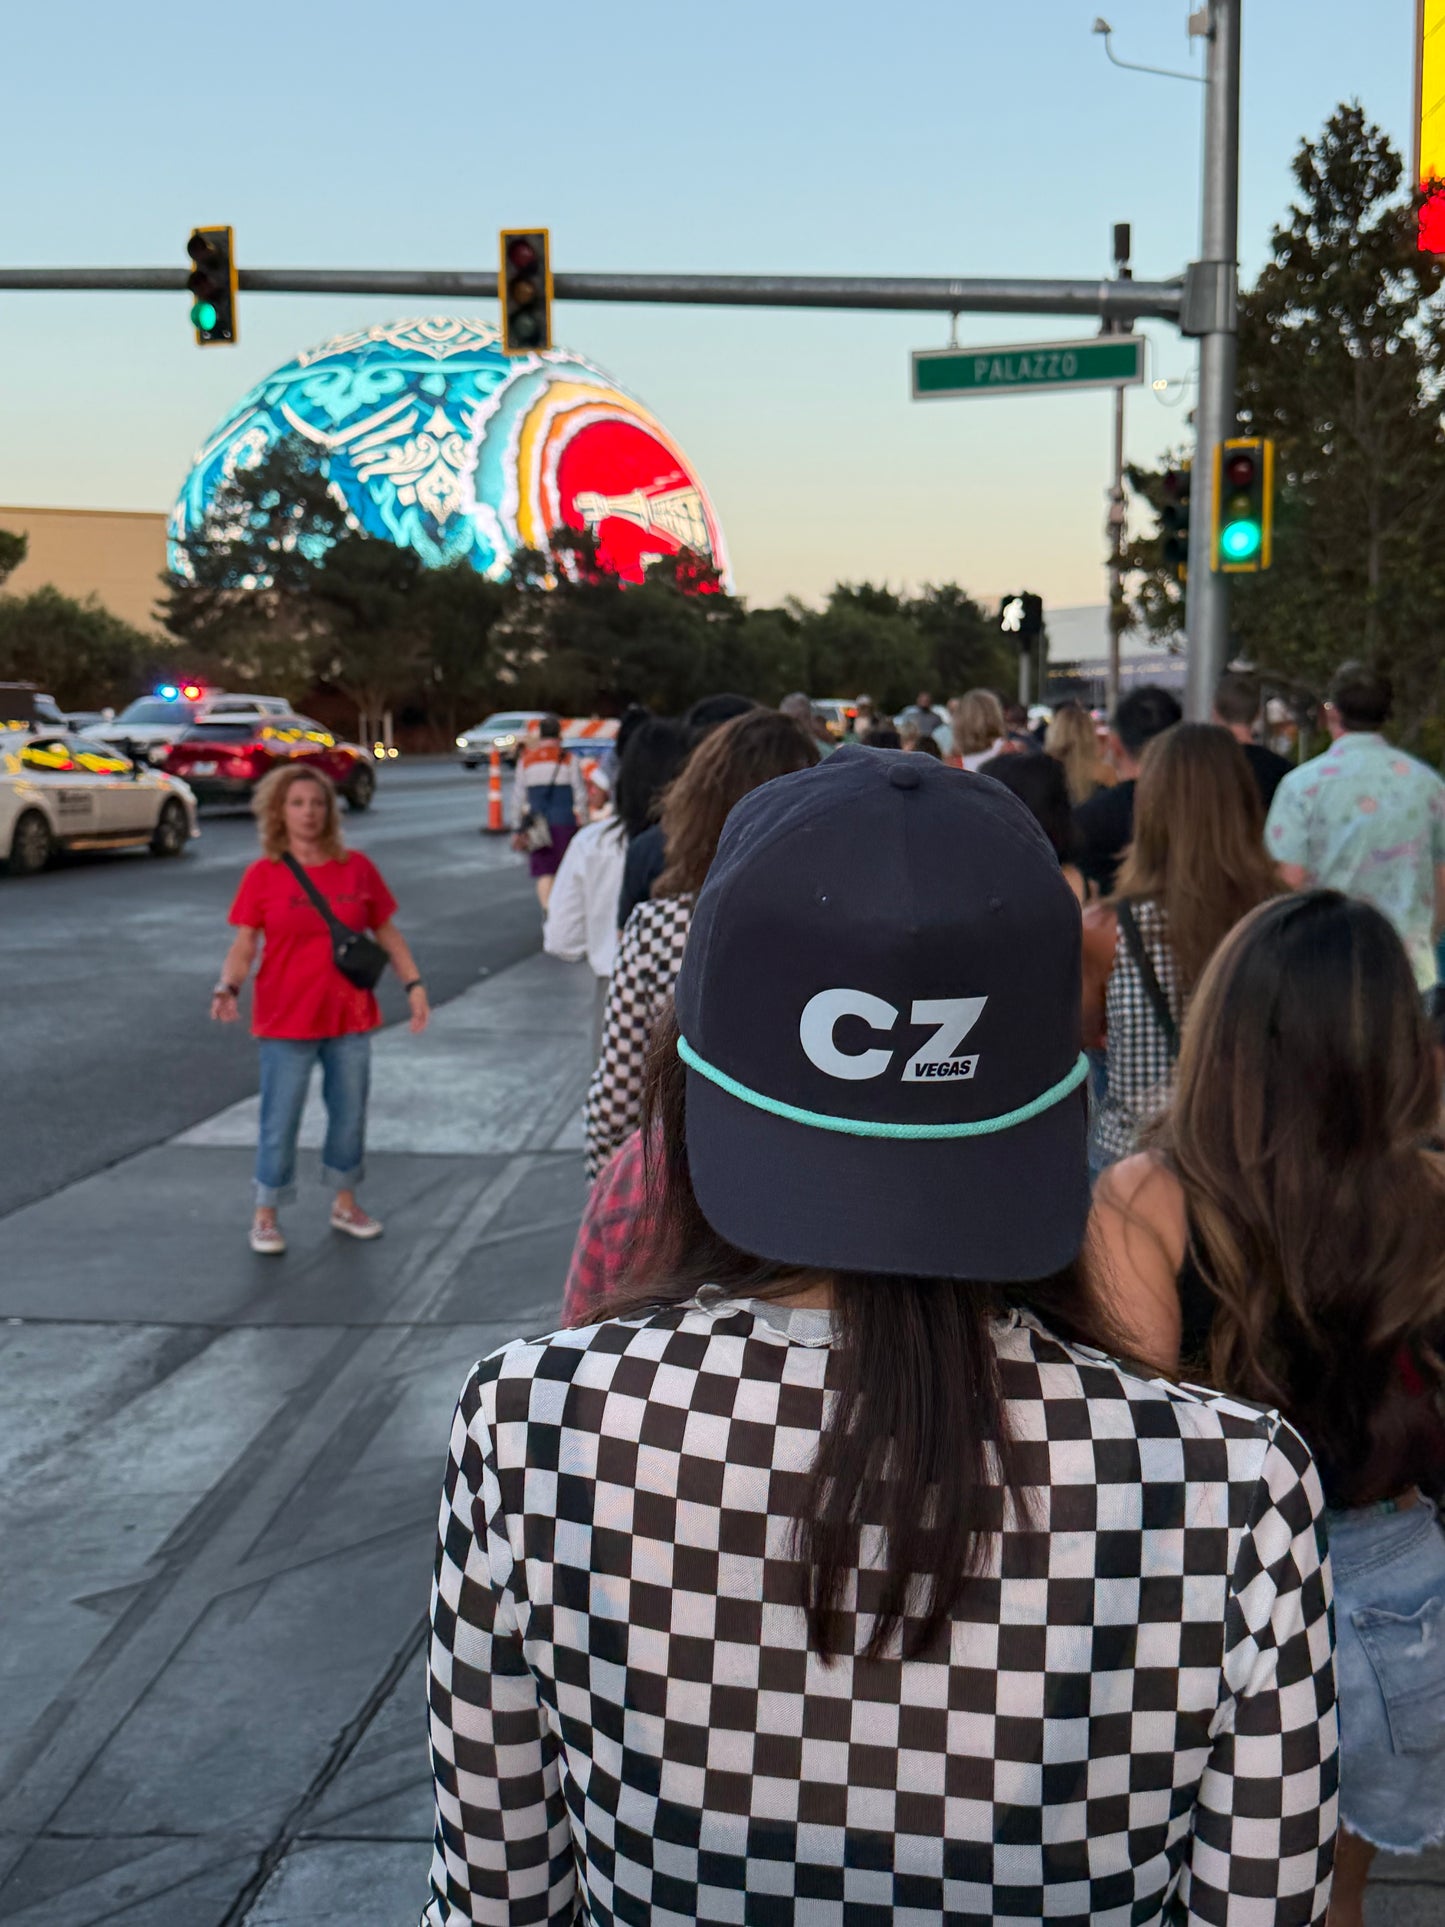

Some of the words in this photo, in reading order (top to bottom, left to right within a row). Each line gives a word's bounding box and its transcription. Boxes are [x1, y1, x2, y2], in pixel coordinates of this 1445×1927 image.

[974, 352, 1078, 382] PALAZZO
[800, 988, 989, 1082] CZ
[914, 1060, 972, 1078] VEGAS
